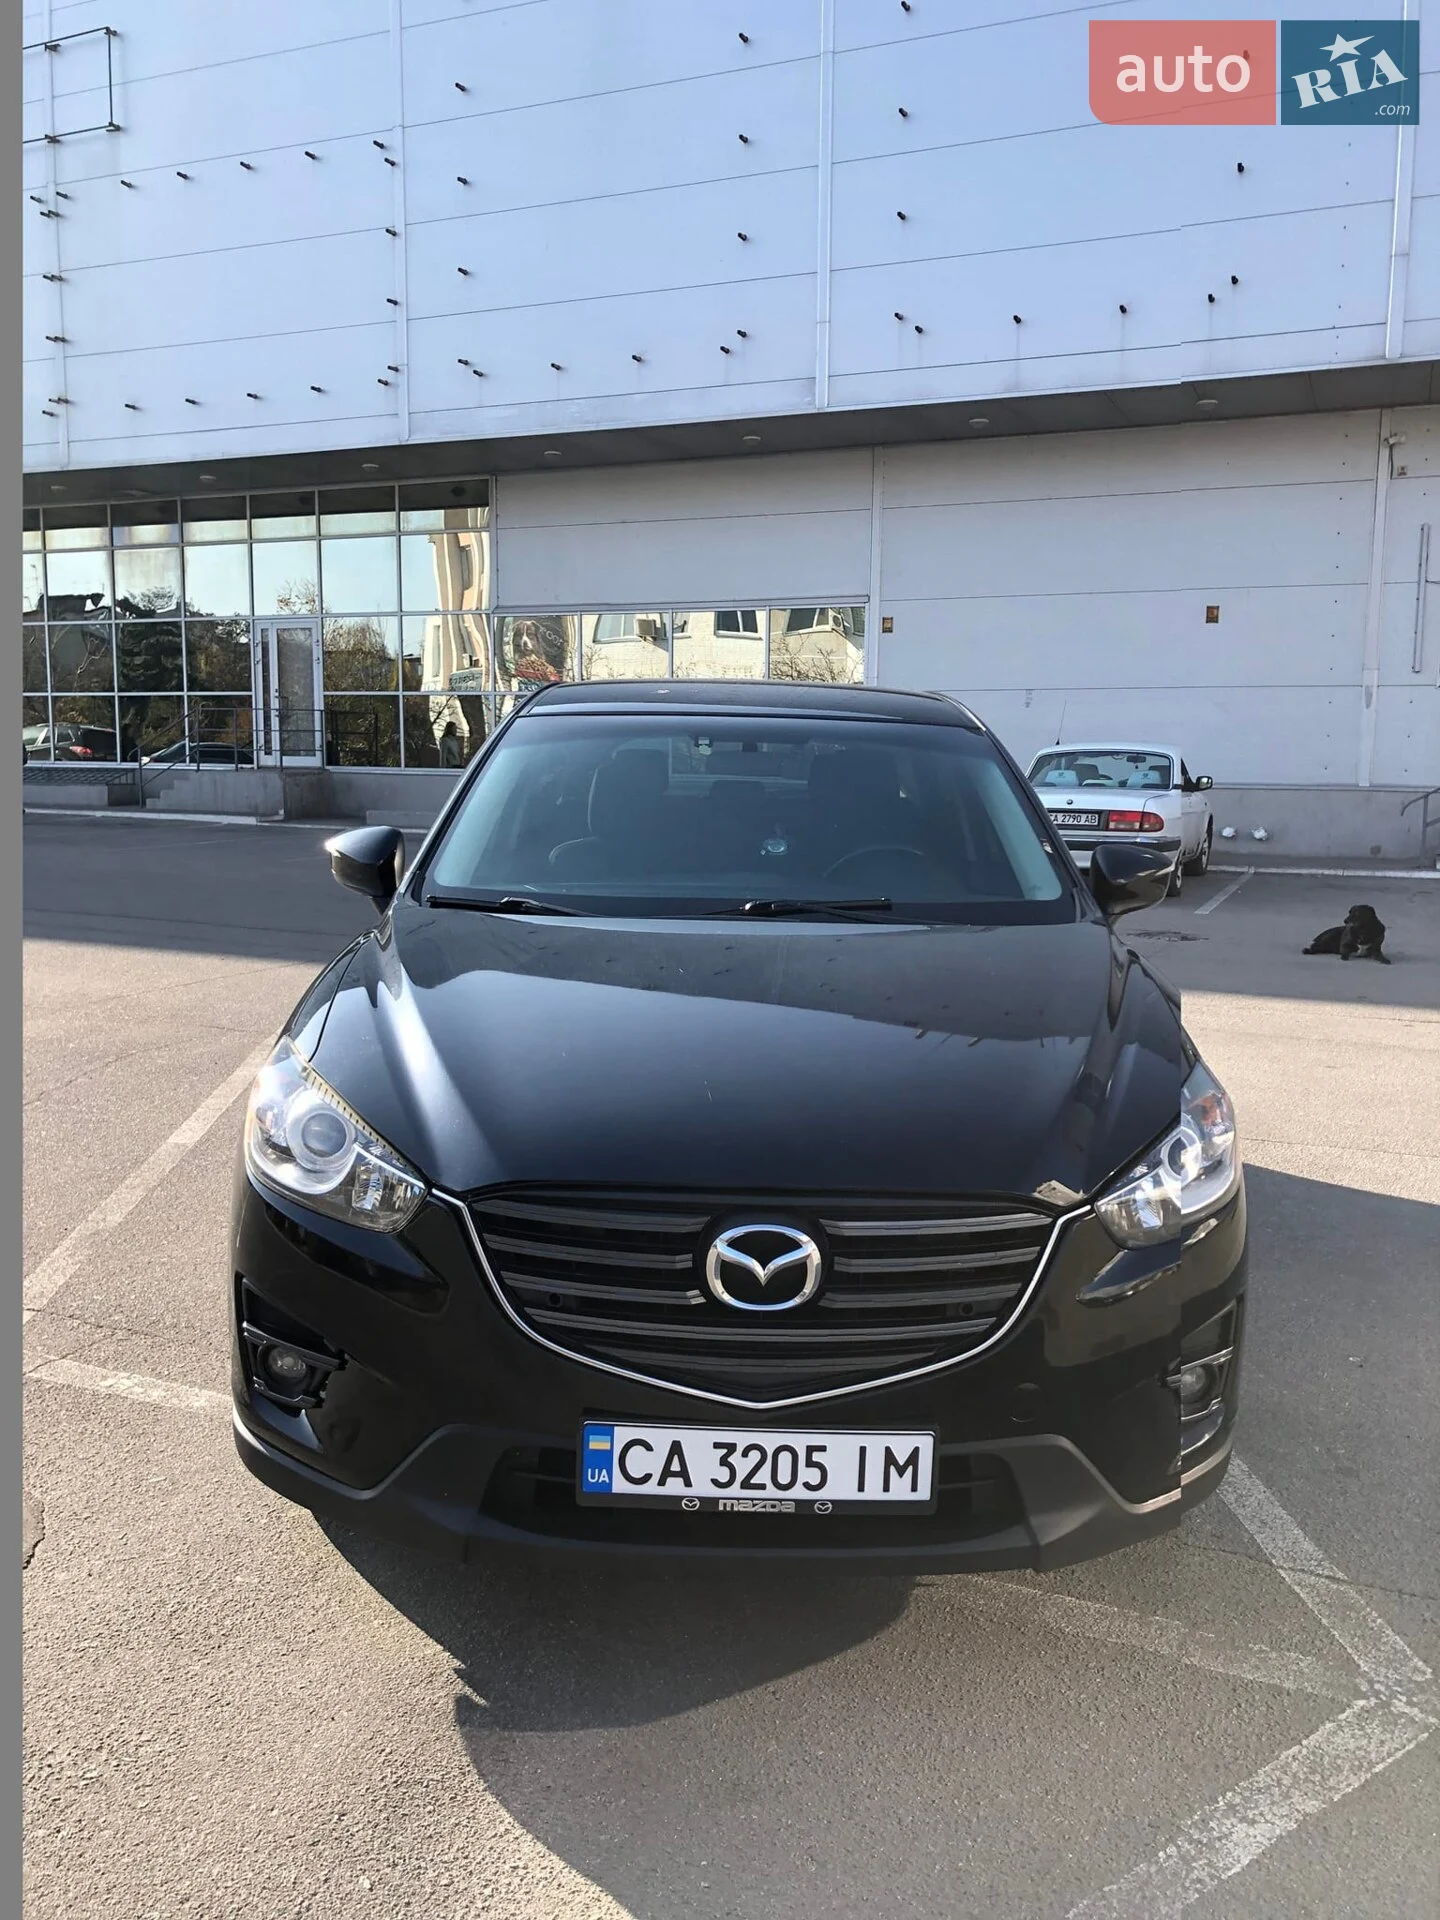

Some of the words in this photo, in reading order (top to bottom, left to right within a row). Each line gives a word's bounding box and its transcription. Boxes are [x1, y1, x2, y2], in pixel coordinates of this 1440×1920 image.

[1061, 814, 1082, 823] 2790
[1084, 815, 1097, 824] AB
[618, 1438, 693, 1487] CA
[710, 1442, 828, 1491] 3205
[857, 1446, 920, 1493] IM
[588, 1469, 609, 1483] UA
